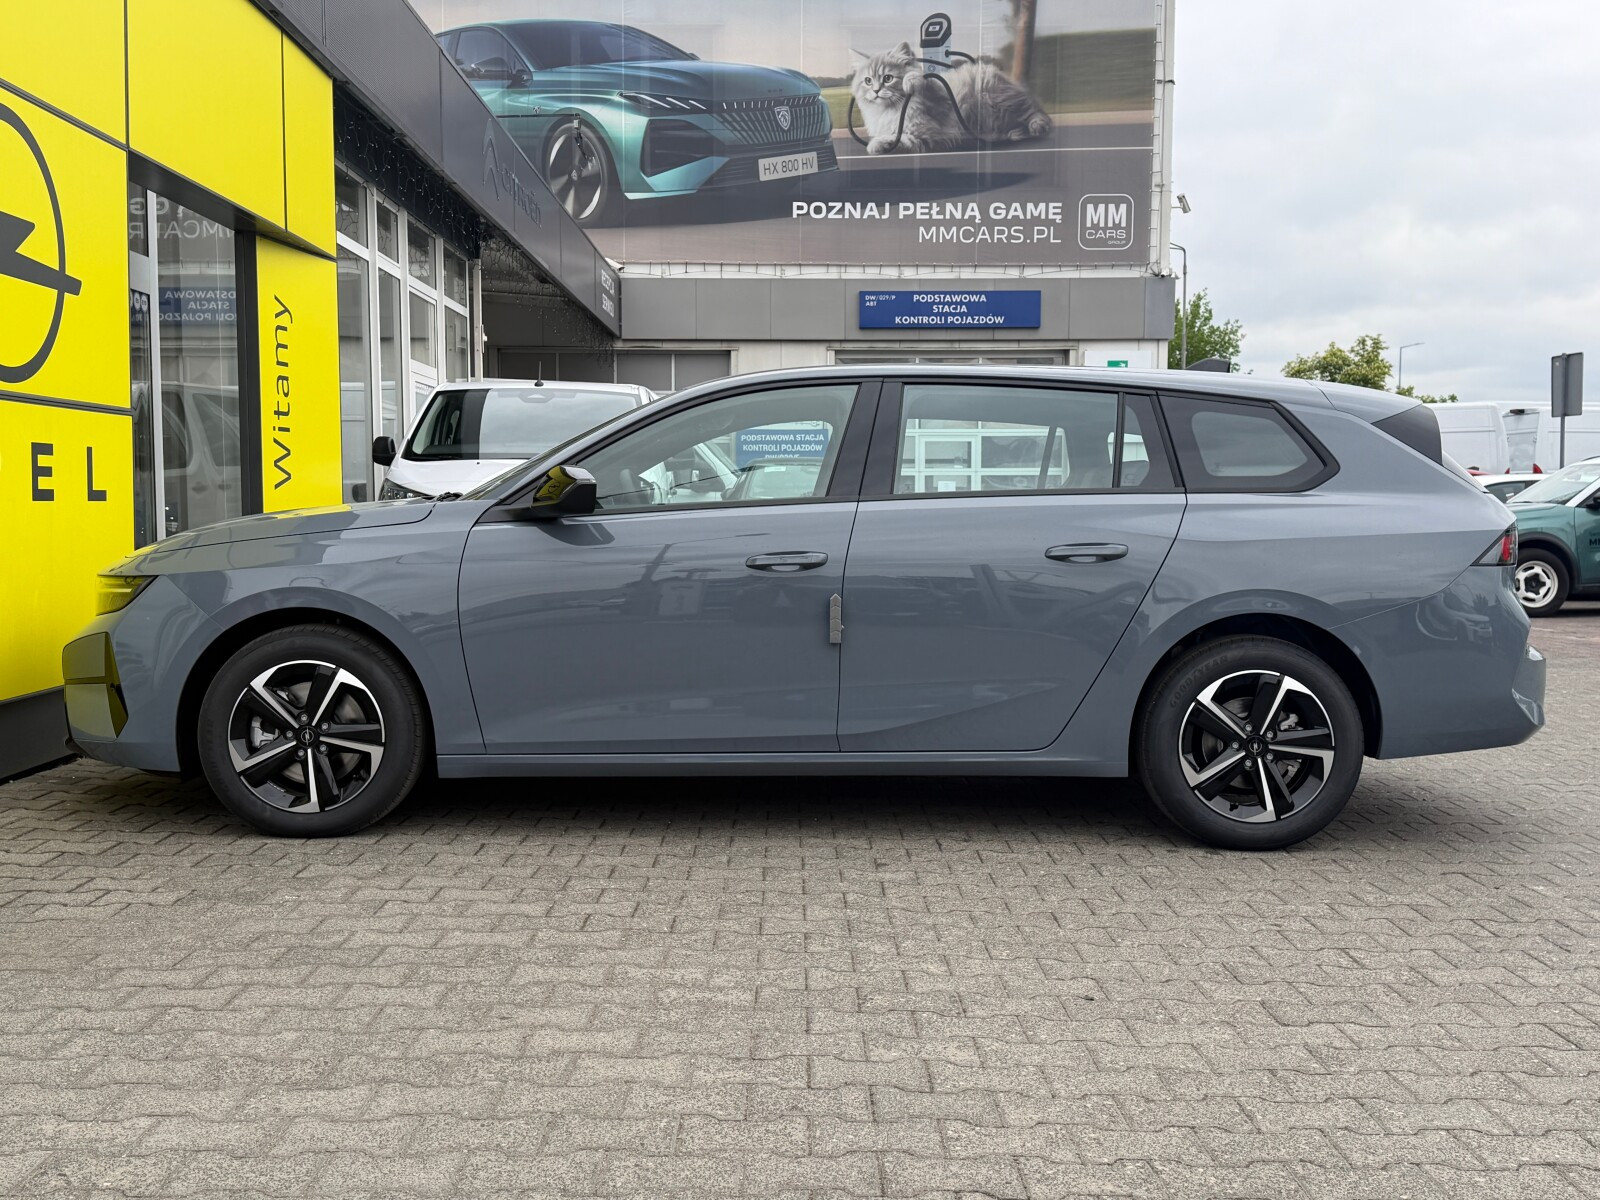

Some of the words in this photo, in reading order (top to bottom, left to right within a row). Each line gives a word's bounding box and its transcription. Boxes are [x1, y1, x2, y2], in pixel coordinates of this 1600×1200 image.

[763, 162, 779, 176] HX
[781, 159, 799, 173] 800
[801, 156, 815, 170] HV
[791, 201, 890, 220] POZNAJ
[898, 201, 982, 224] PEŁNĄ
[988, 201, 1063, 224] GAMĘ
[1085, 203, 1127, 228] MM
[917, 225, 1062, 244] MMCARS.PL
[1085, 229, 1127, 239] CARS
[913, 294, 987, 303] PODSTAWOWA
[932, 305, 968, 313] STACJA
[895, 316, 945, 325] KONTROLI
[947, 314, 1005, 325] POJAZDÓW
[273, 294, 293, 490] Witamy
[741, 434, 795, 442] PODSTAWOWA
[795, 433, 825, 441] STACJA
[742, 444, 780, 452] KONTROLI
[781, 443, 823, 452] POJAZDÓW
[1169, 654, 1228, 709] GOODYEAR
